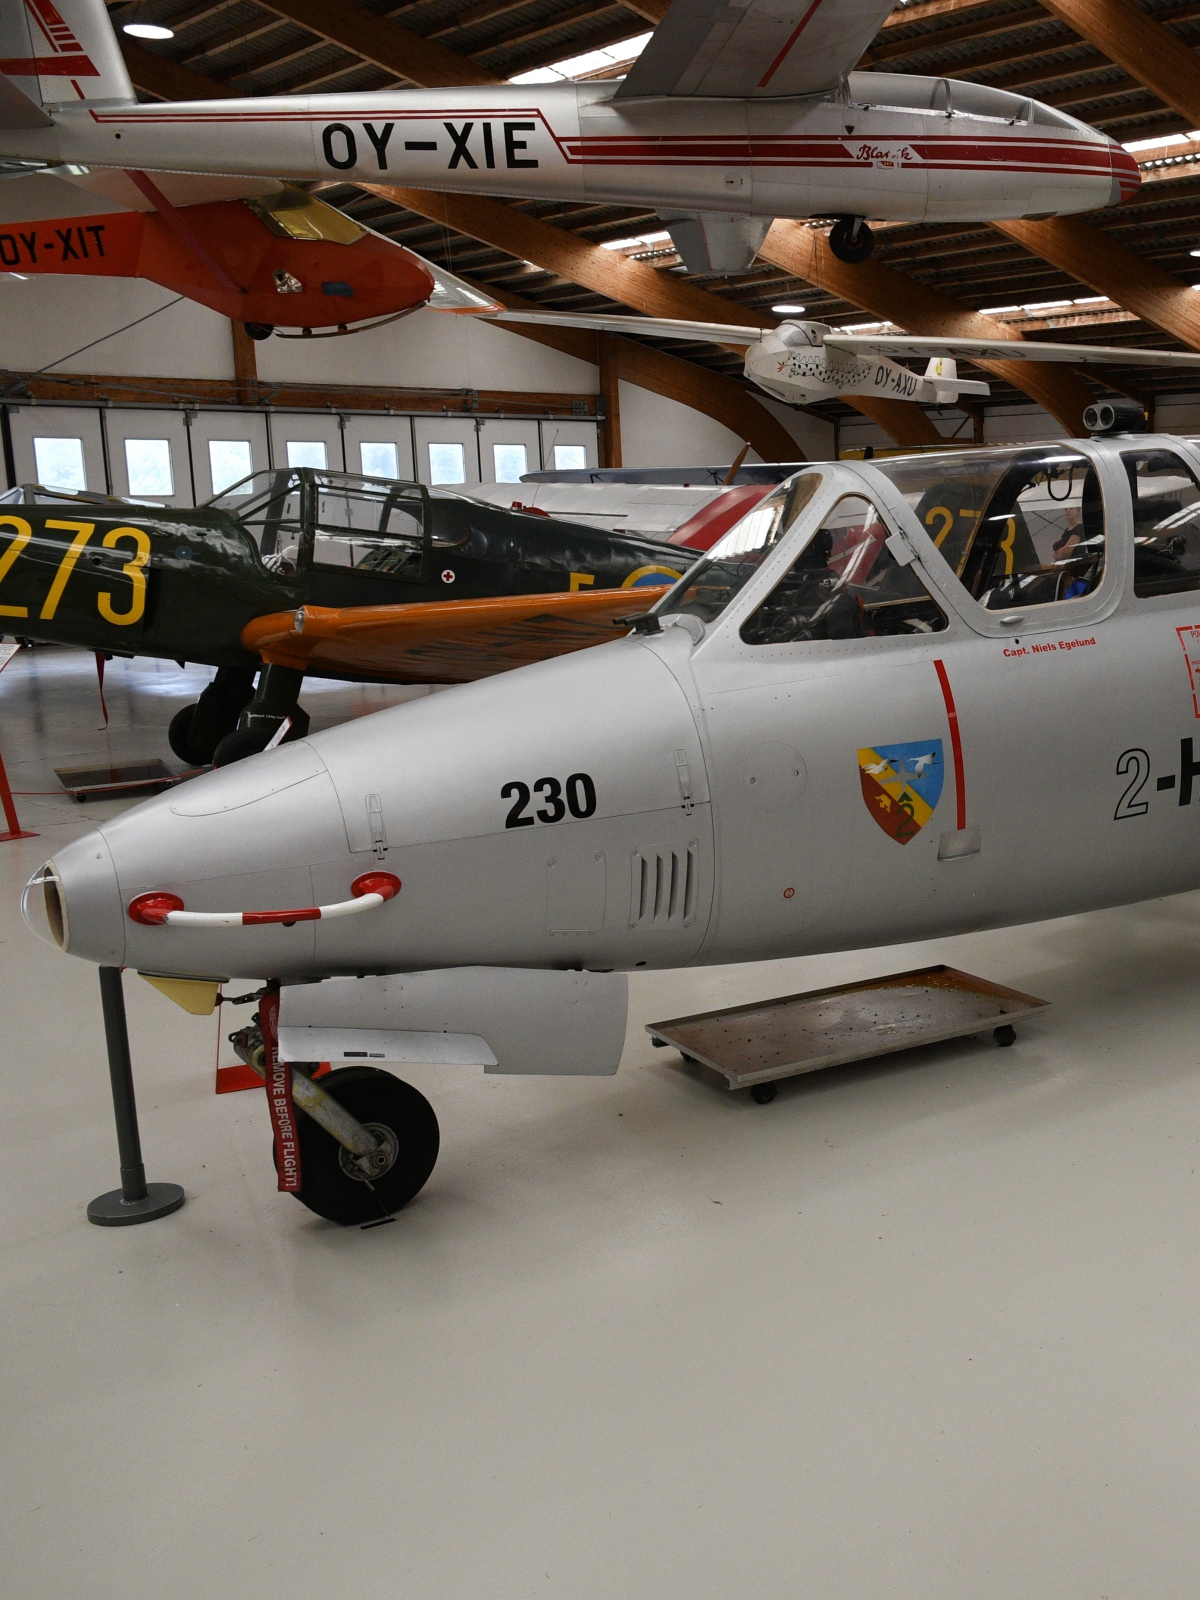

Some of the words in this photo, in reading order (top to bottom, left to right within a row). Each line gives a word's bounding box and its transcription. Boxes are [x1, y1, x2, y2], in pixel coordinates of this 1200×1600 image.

[321, 121, 539, 171] OY-XIE
[0, 225, 106, 266] OY-XIT
[874, 365, 918, 397] OY-AXU
[0, 514, 152, 626] 273
[1002, 647, 1031, 658] Capt.
[1031, 643, 1057, 654] Niels
[1058, 636, 1097, 651] Egelund
[500, 772, 597, 829] 230
[896, 802, 915, 838] 2
[273, 1097, 294, 1140] BEFORE
[282, 1141, 298, 1187] FLIGHT!
